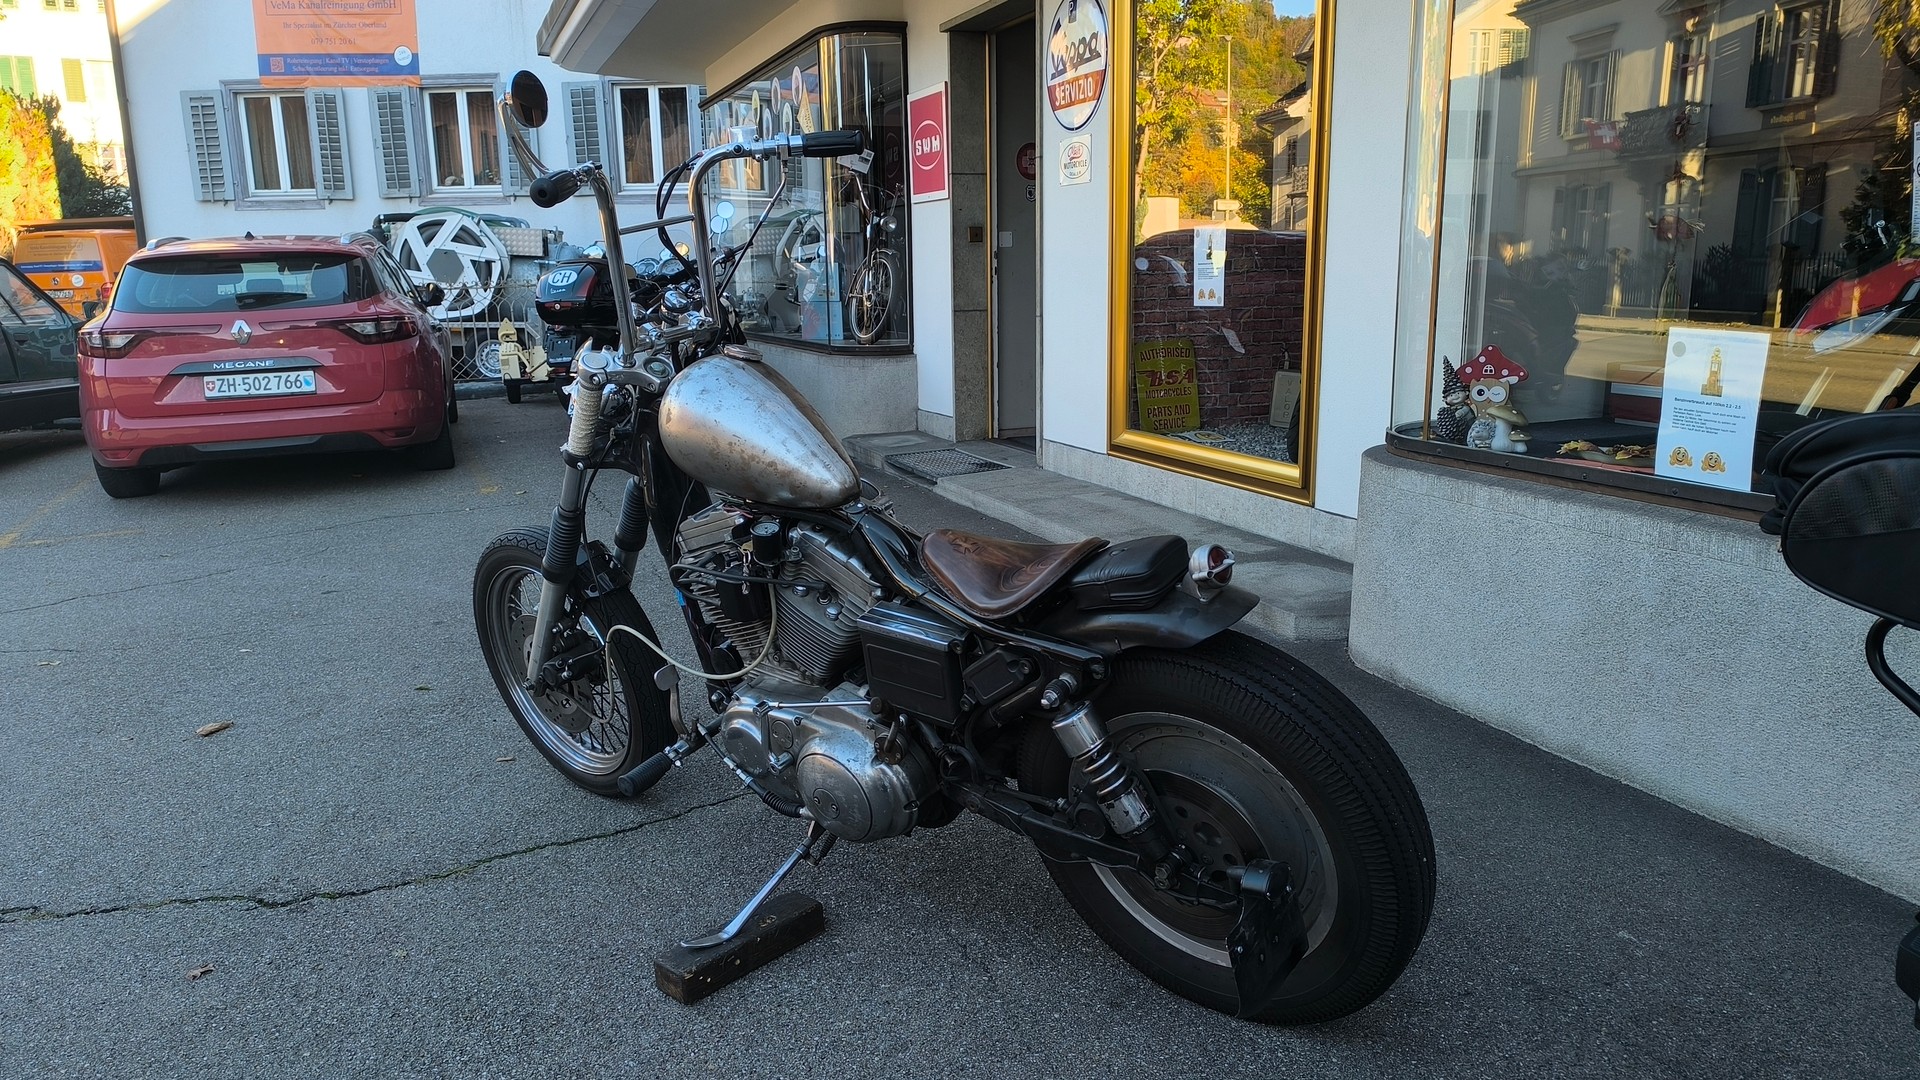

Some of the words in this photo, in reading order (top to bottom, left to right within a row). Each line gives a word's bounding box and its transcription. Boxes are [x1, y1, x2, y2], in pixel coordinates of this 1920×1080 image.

[271, 0, 296, 10] VeMa
[298, 0, 365, 12] Kanalreinigung
[367, 0, 397, 9] GmbH
[333, 21, 357, 29] Zürcher
[358, 21, 387, 29] Oberland
[325, 38, 336, 46] 751
[341, 57, 350, 65] TV
[1055, 77, 1093, 107] SERVIZIO
[915, 134, 940, 156] SWM
[1063, 159, 1087, 169] MOTORCYCLE
[552, 271, 572, 284] CH
[1140, 346, 1191, 362] AUTHORISED
[213, 360, 275, 370] MEGANE
[1149, 368, 1194, 387] BSA
[1145, 386, 1192, 399] MOTORCYCLES
[1147, 405, 1172, 419] PARTS
[1174, 403, 1191, 416] AND
[1153, 417, 1186, 431] SERVICE
